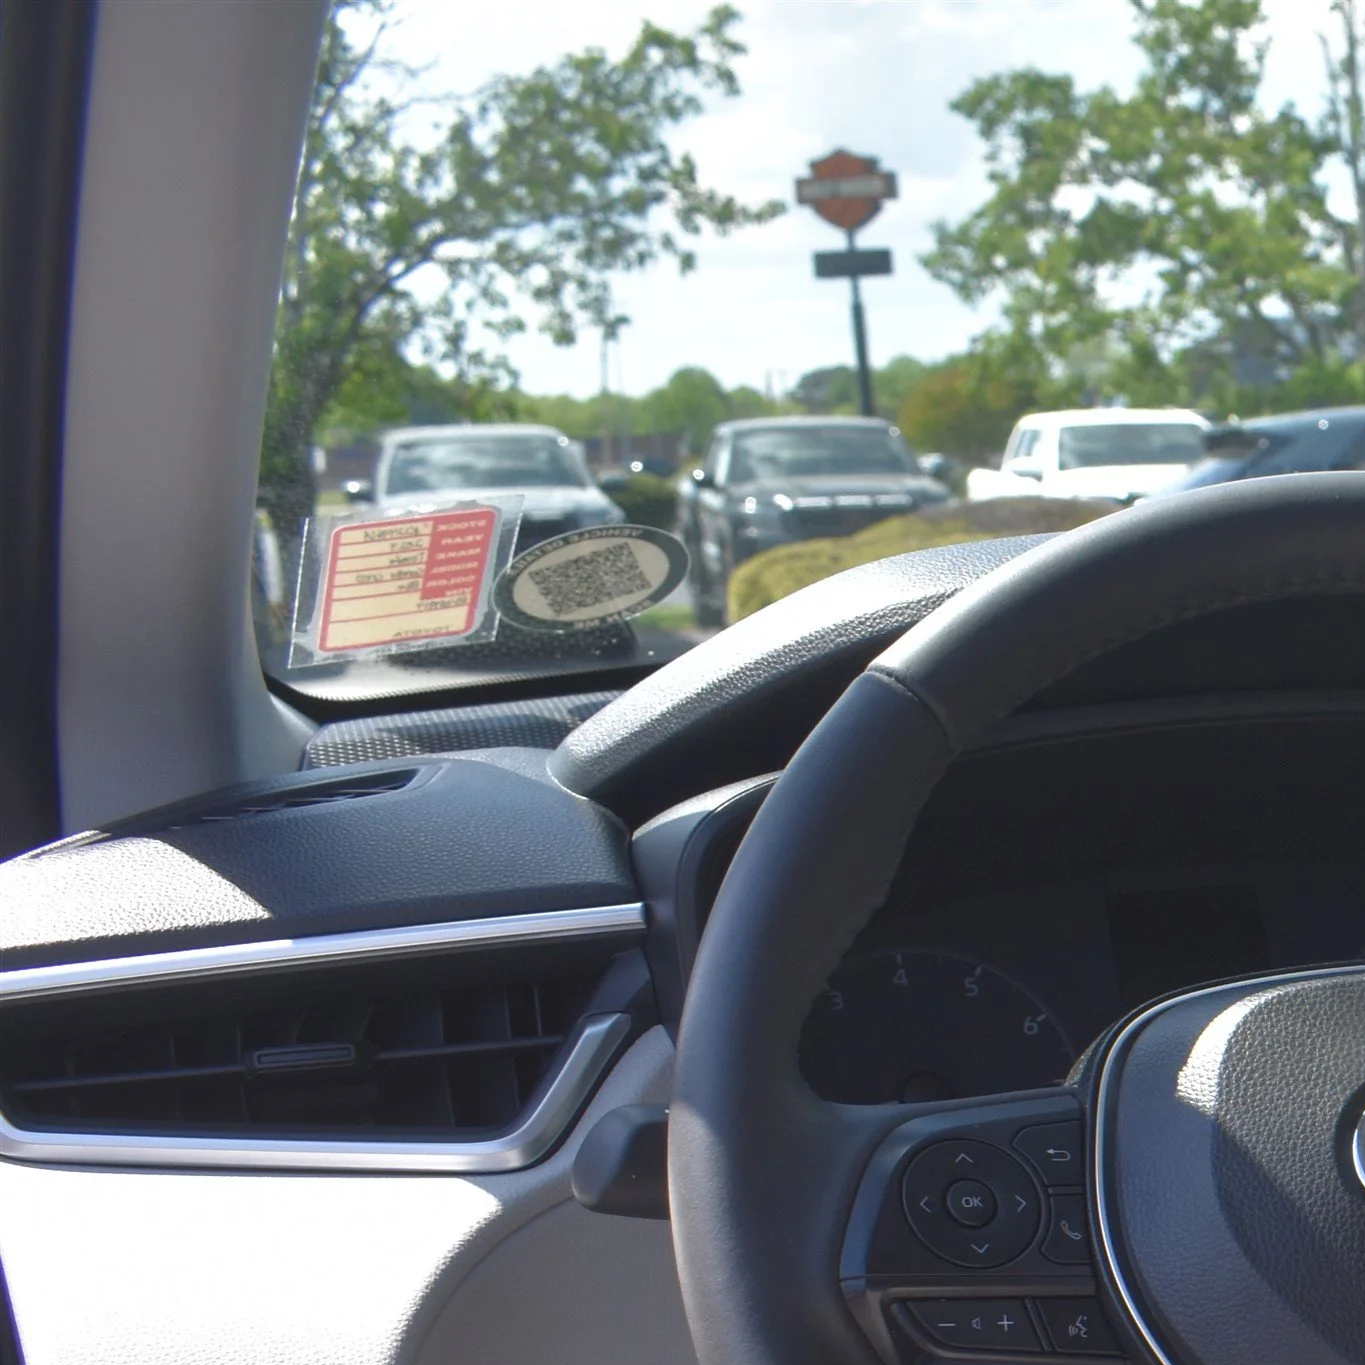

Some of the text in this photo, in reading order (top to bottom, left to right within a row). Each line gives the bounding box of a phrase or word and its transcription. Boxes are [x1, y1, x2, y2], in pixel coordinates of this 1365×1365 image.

[892, 968, 908, 988] 4
[963, 978, 980, 998] 5
[827, 989, 844, 1011] 3
[1023, 1015, 1039, 1037] 6
[960, 1195, 983, 1209] OK
